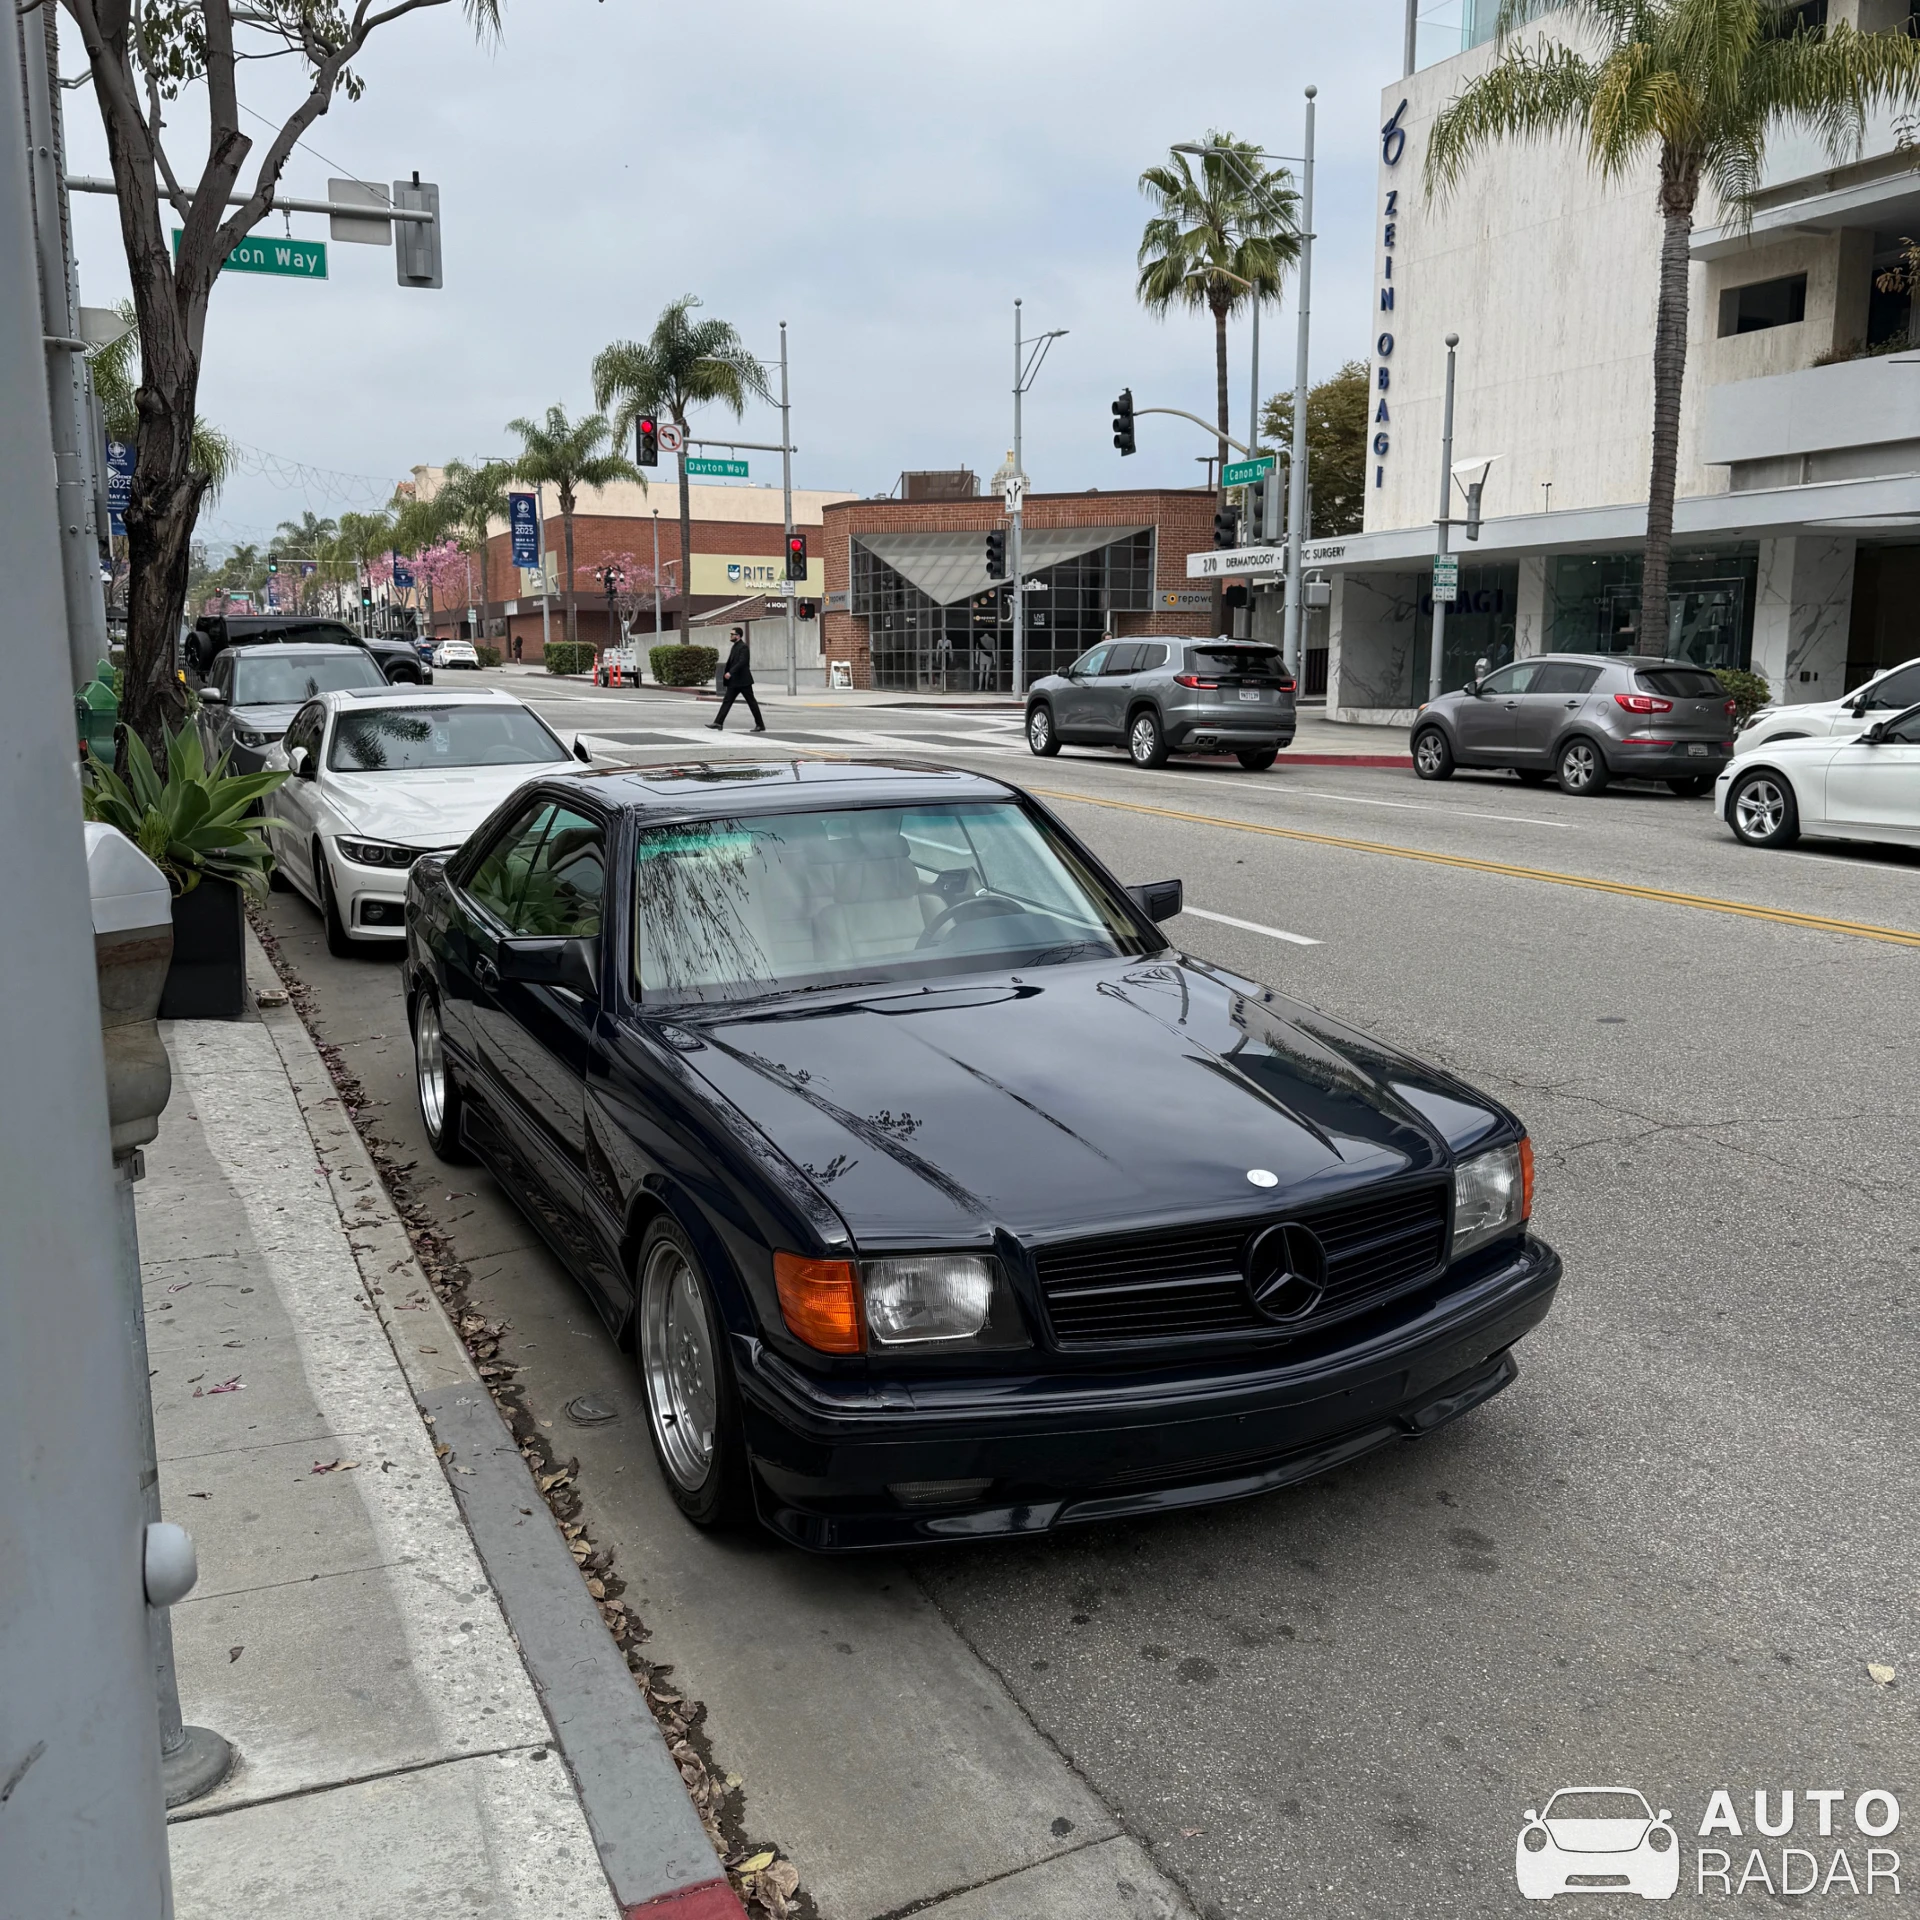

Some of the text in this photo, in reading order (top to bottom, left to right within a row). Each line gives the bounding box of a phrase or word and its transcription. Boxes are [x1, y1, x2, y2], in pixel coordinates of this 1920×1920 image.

[275, 247, 317, 273] Way
[1373, 190, 1398, 488] ZEIN OBAGI
[688, 461, 745, 475] Dayton Way
[1229, 468, 1253, 481] Canon
[515, 527, 534, 535] 2025
[1203, 557, 1217, 572] 270
[1226, 553, 1274, 568] DERMATOLOGY
[1312, 546, 1346, 559] SURGERY
[743, 566, 775, 580] RITE
[745, 581, 781, 589] PHARMAC
[1162, 592, 1213, 606] corepowe
